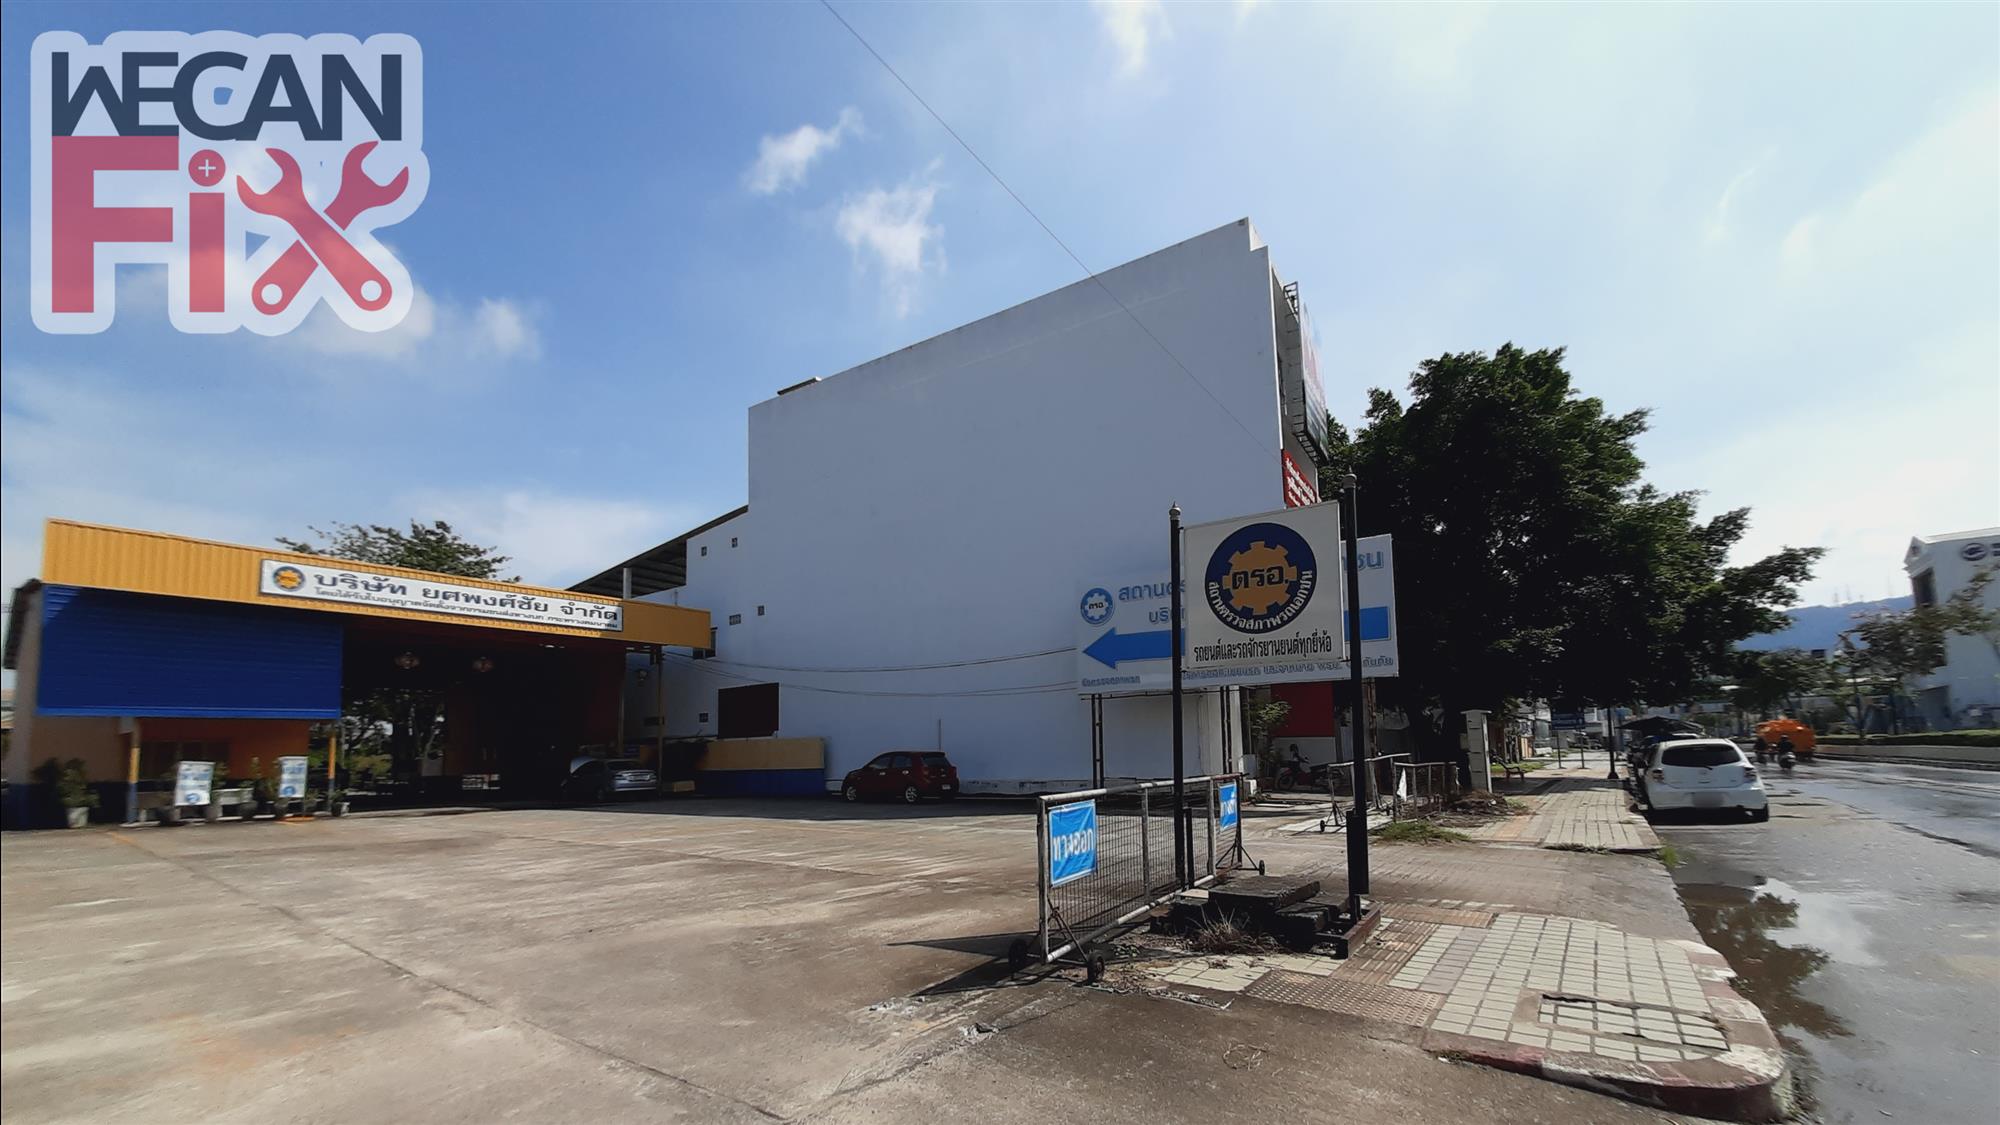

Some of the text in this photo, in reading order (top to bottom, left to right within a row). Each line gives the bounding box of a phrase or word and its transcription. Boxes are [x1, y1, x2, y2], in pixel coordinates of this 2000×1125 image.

[314, 573, 407, 596] บริษัท
[560, 602, 618, 621] จำกัด
